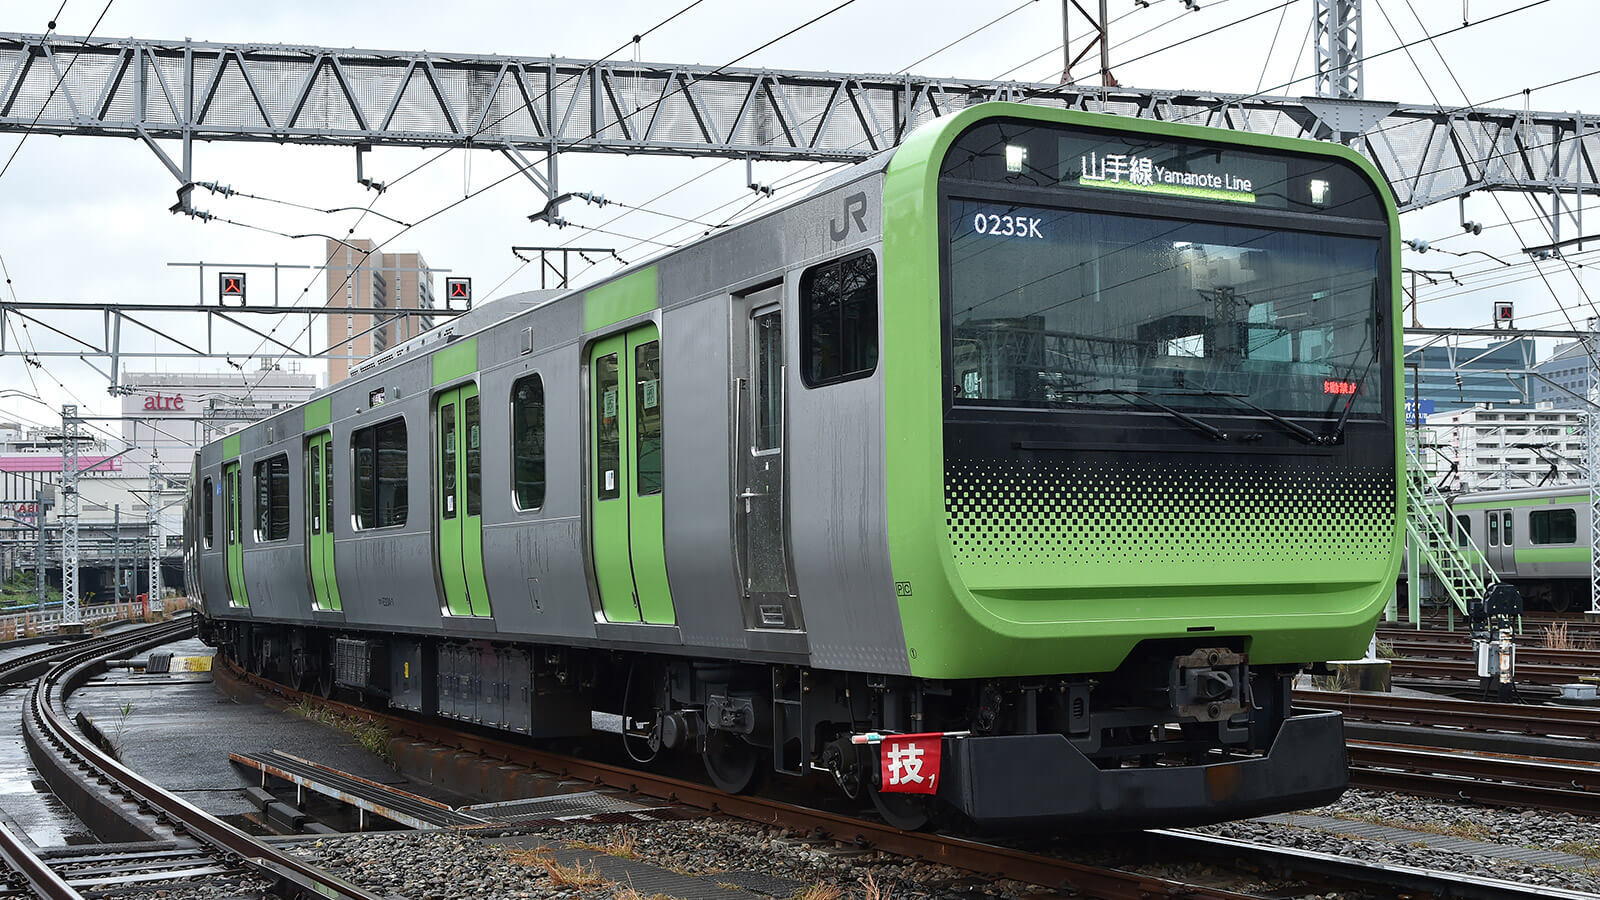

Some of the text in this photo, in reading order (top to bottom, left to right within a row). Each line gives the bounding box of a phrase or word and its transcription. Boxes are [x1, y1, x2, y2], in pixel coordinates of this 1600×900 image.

[1082, 152, 1252, 191] 山手線 Yamanote Line
[830, 191, 867, 241] JR
[975, 213, 1043, 238] 0235K
[144, 392, 184, 410] atré
[887, 743, 924, 785] 技
[928, 773, 936, 789] 1
